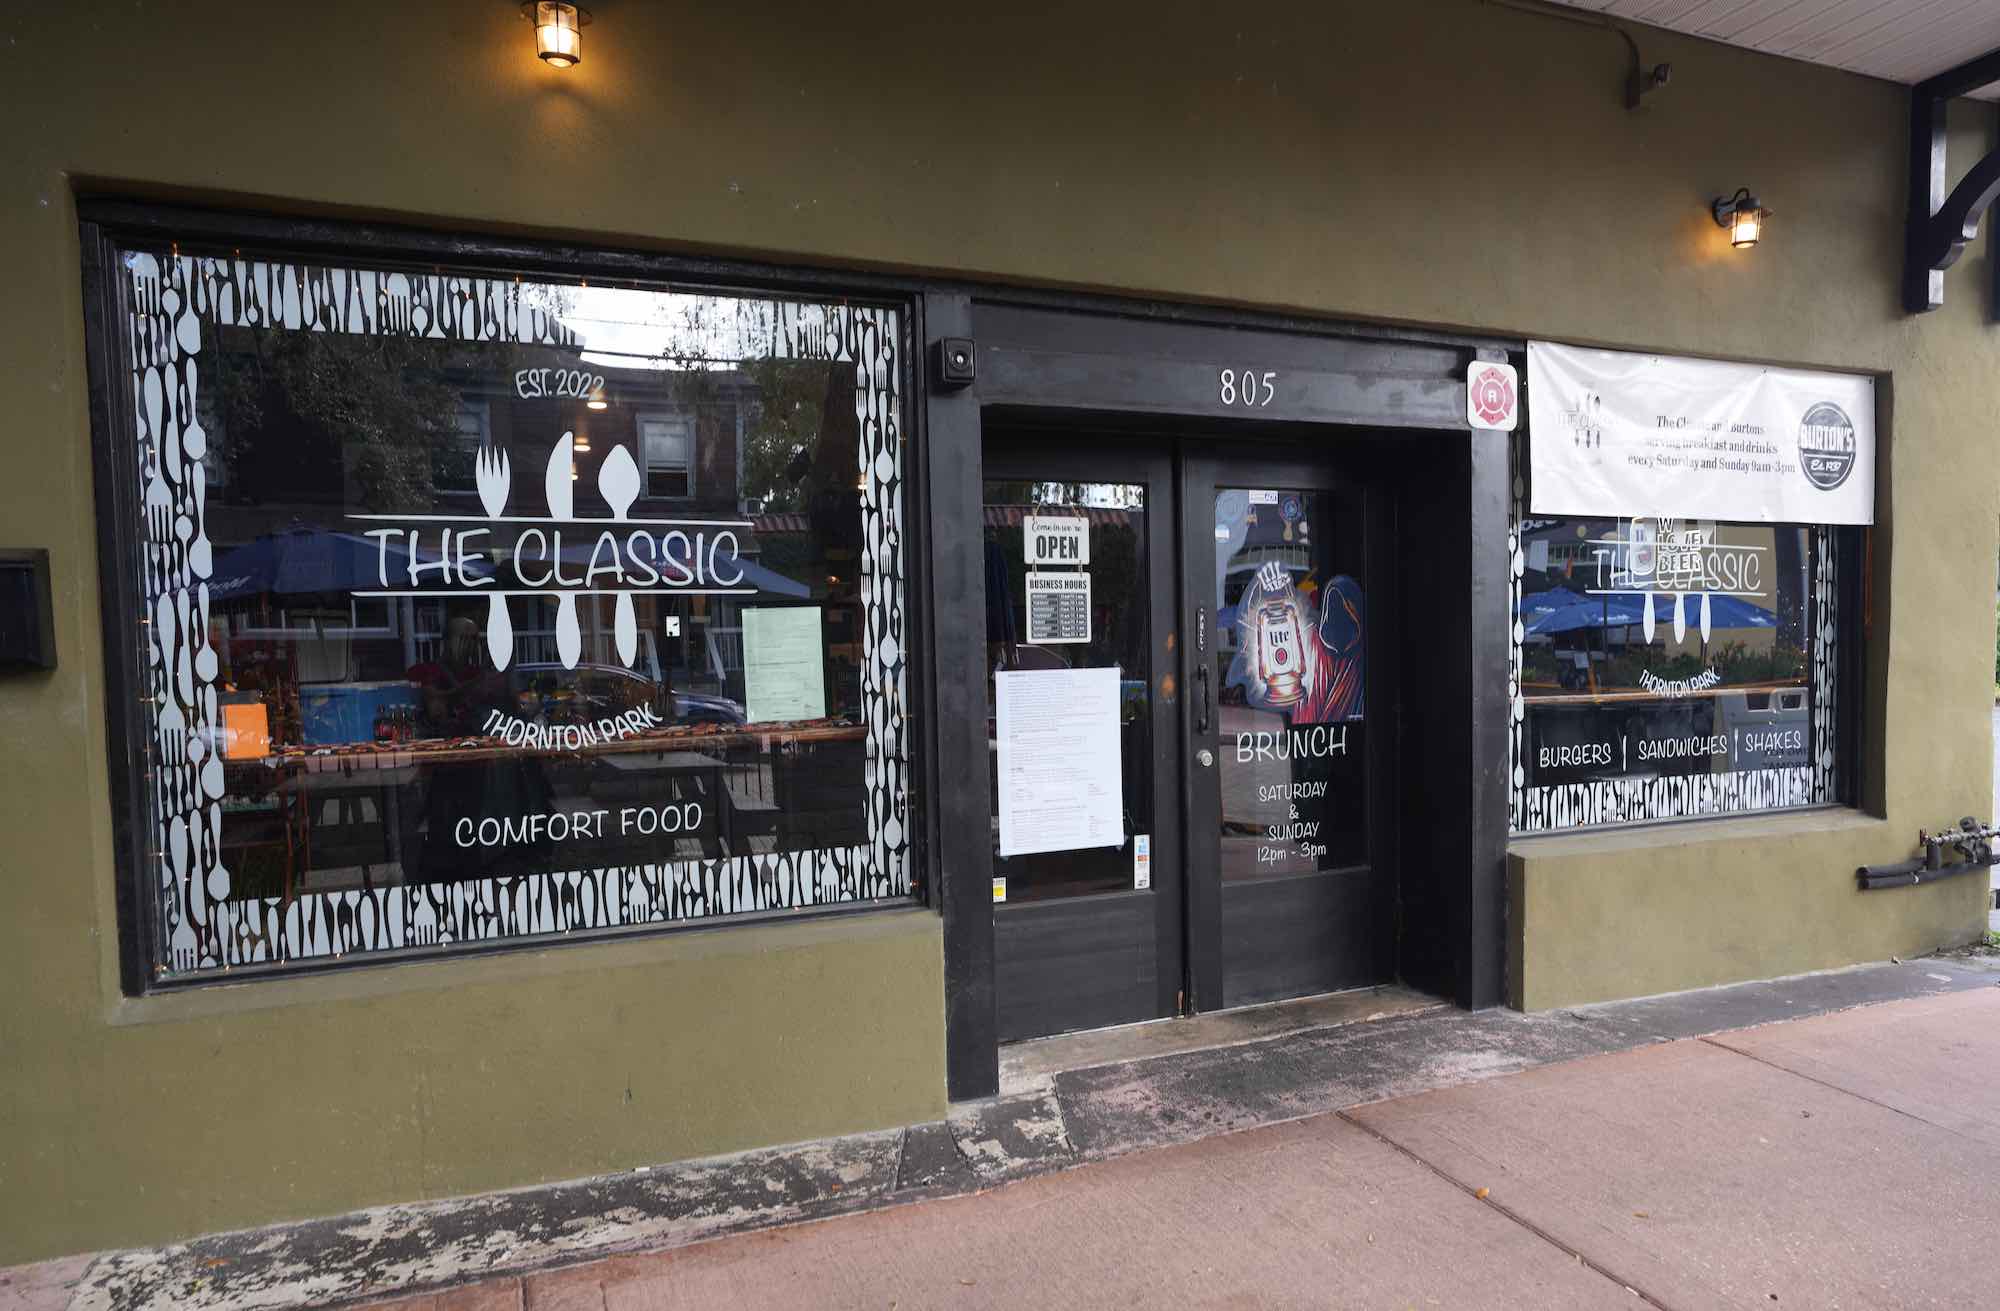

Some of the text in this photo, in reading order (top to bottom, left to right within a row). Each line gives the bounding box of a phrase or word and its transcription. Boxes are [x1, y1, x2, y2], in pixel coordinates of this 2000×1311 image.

[515, 368, 605, 400] EST. 2022
[1220, 368, 1277, 407] 805
[1656, 415, 1675, 429] The
[1800, 423, 1854, 453] BURTON'S
[1700, 456, 1717, 470] and
[1718, 457, 1750, 474] Sunday
[363, 527, 744, 589] THE CLASSIC
[1035, 535, 1079, 559] OPEN
[1029, 579, 1087, 590] BUSINESS HOURS
[1638, 665, 1721, 699] THORNTON PARK
[481, 702, 664, 752] THORNTON PARK
[1236, 725, 1347, 763] BRUNCH
[1539, 730, 1801, 769] BURGERS SANDWICHES SHAKES
[1258, 781, 1328, 802] SATURDAY
[455, 802, 703, 848] COMFORT FOOD
[1288, 803, 1300, 820] &
[1268, 821, 1320, 842] SUNDAY
[1257, 846, 1287, 866] 12pm
[1300, 841, 1328, 862] 3pm
